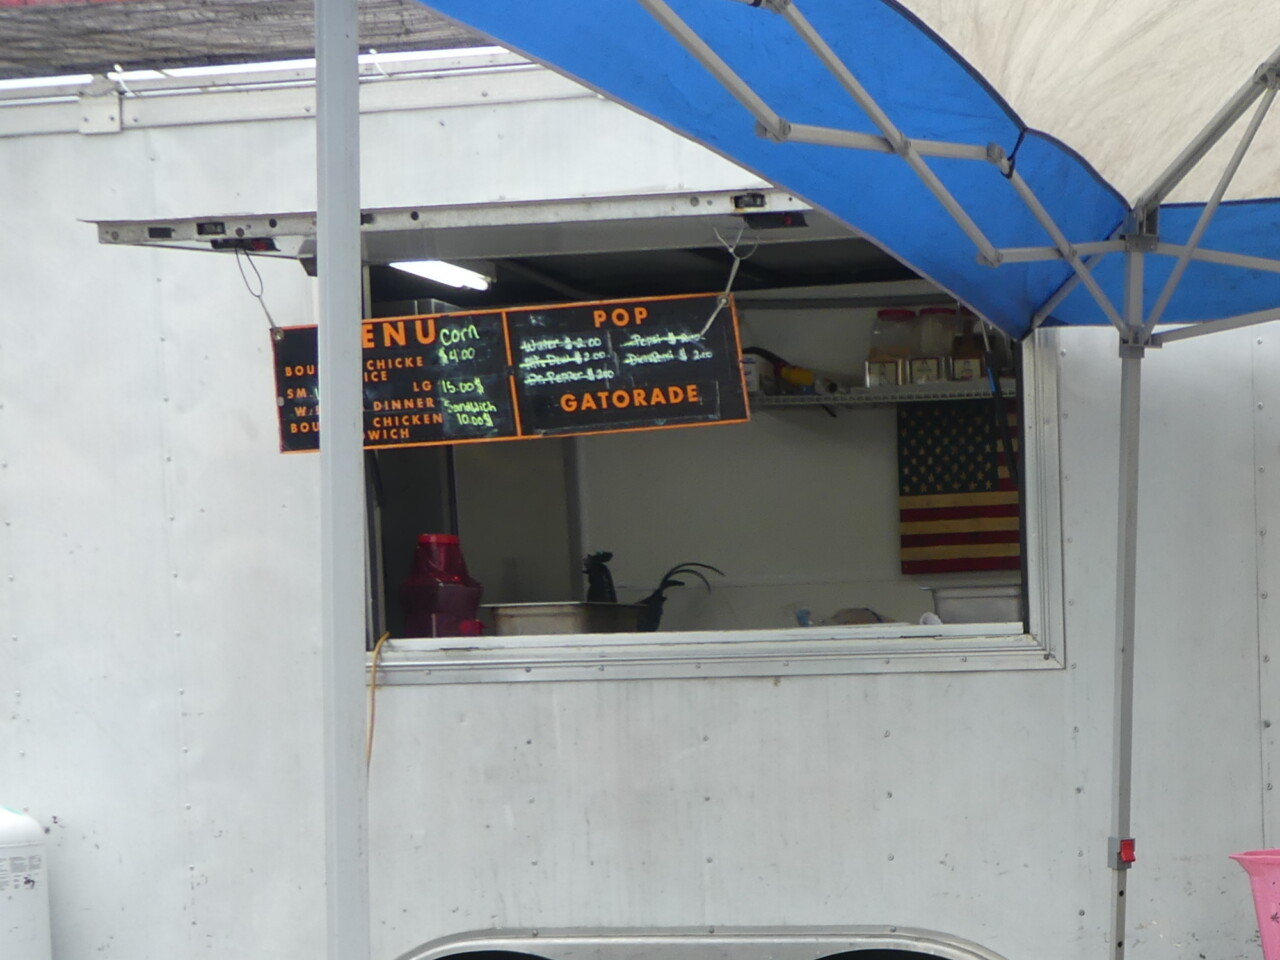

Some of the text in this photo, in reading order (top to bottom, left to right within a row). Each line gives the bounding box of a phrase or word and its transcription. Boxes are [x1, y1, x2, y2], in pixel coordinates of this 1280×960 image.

[593, 307, 648, 328] POP
[361, 319, 436, 349] ENU
[366, 356, 423, 370] CHICKE
[364, 371, 387, 382] ICE
[413, 381, 432, 392] LG
[373, 397, 435, 411] DINNER
[560, 384, 700, 412] GATORADE
[373, 413, 443, 427] CHICKEN
